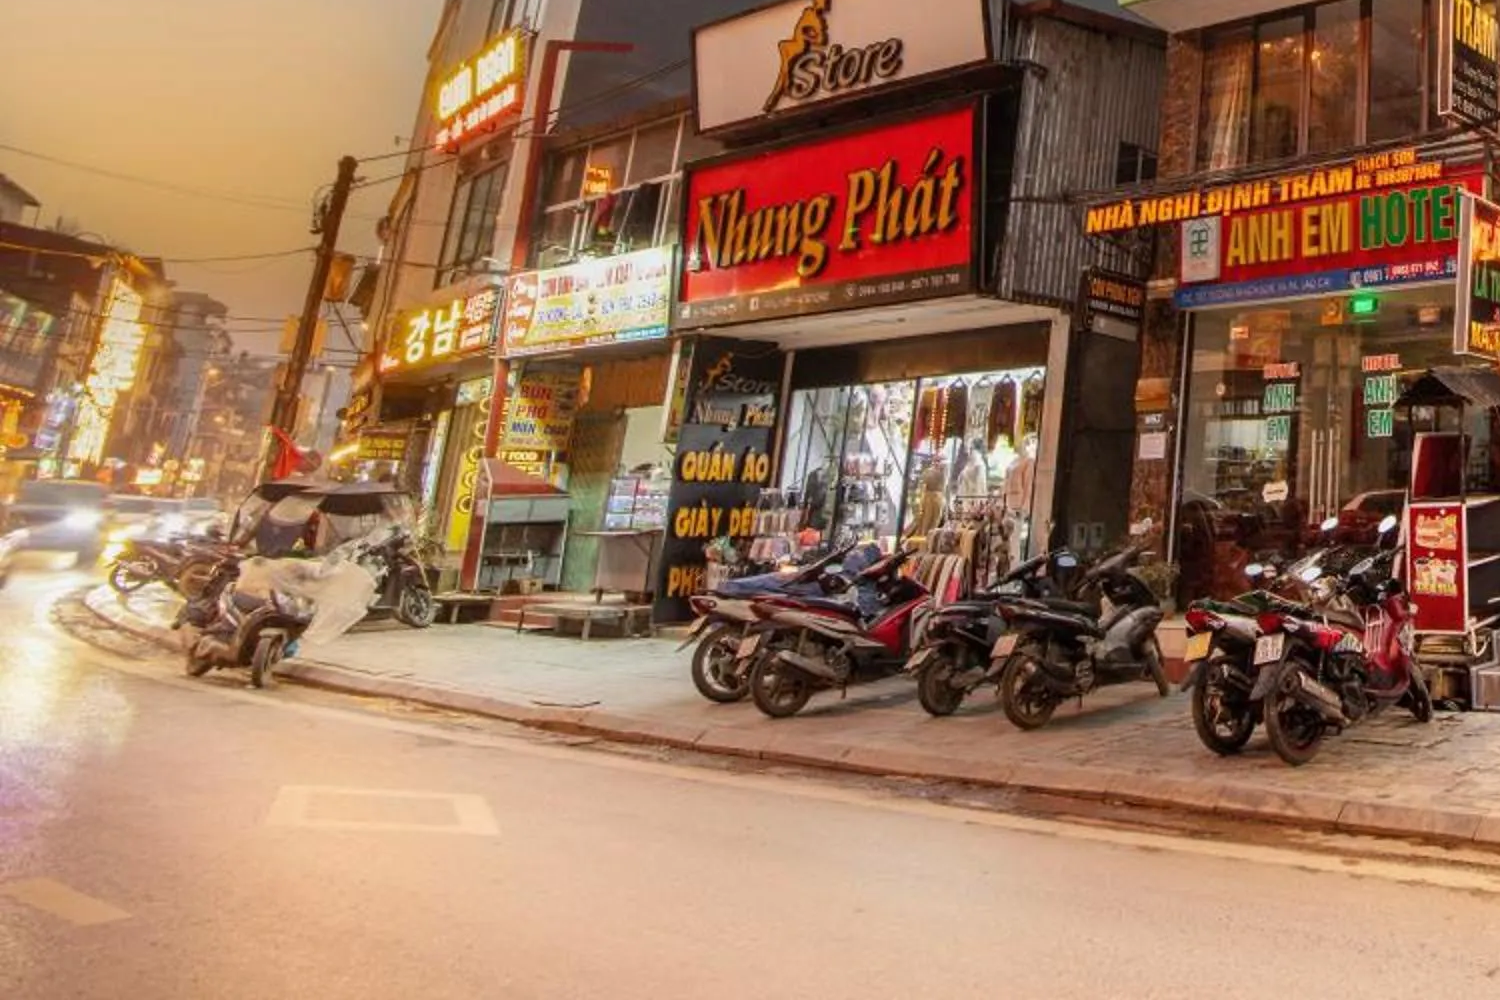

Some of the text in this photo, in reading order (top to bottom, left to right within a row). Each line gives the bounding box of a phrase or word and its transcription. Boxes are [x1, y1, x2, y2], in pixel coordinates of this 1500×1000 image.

[787, 37, 904, 99] Store
[687, 146, 965, 279] Nhung Phát
[1086, 199, 1136, 234] NHÀ
[1226, 209, 1294, 268] ANH
[1302, 200, 1352, 259] EM
[404, 299, 461, 364] 강남
[1363, 375, 1397, 405] ANH
[1368, 409, 1394, 438] EM
[741, 446, 770, 482] ÁO
